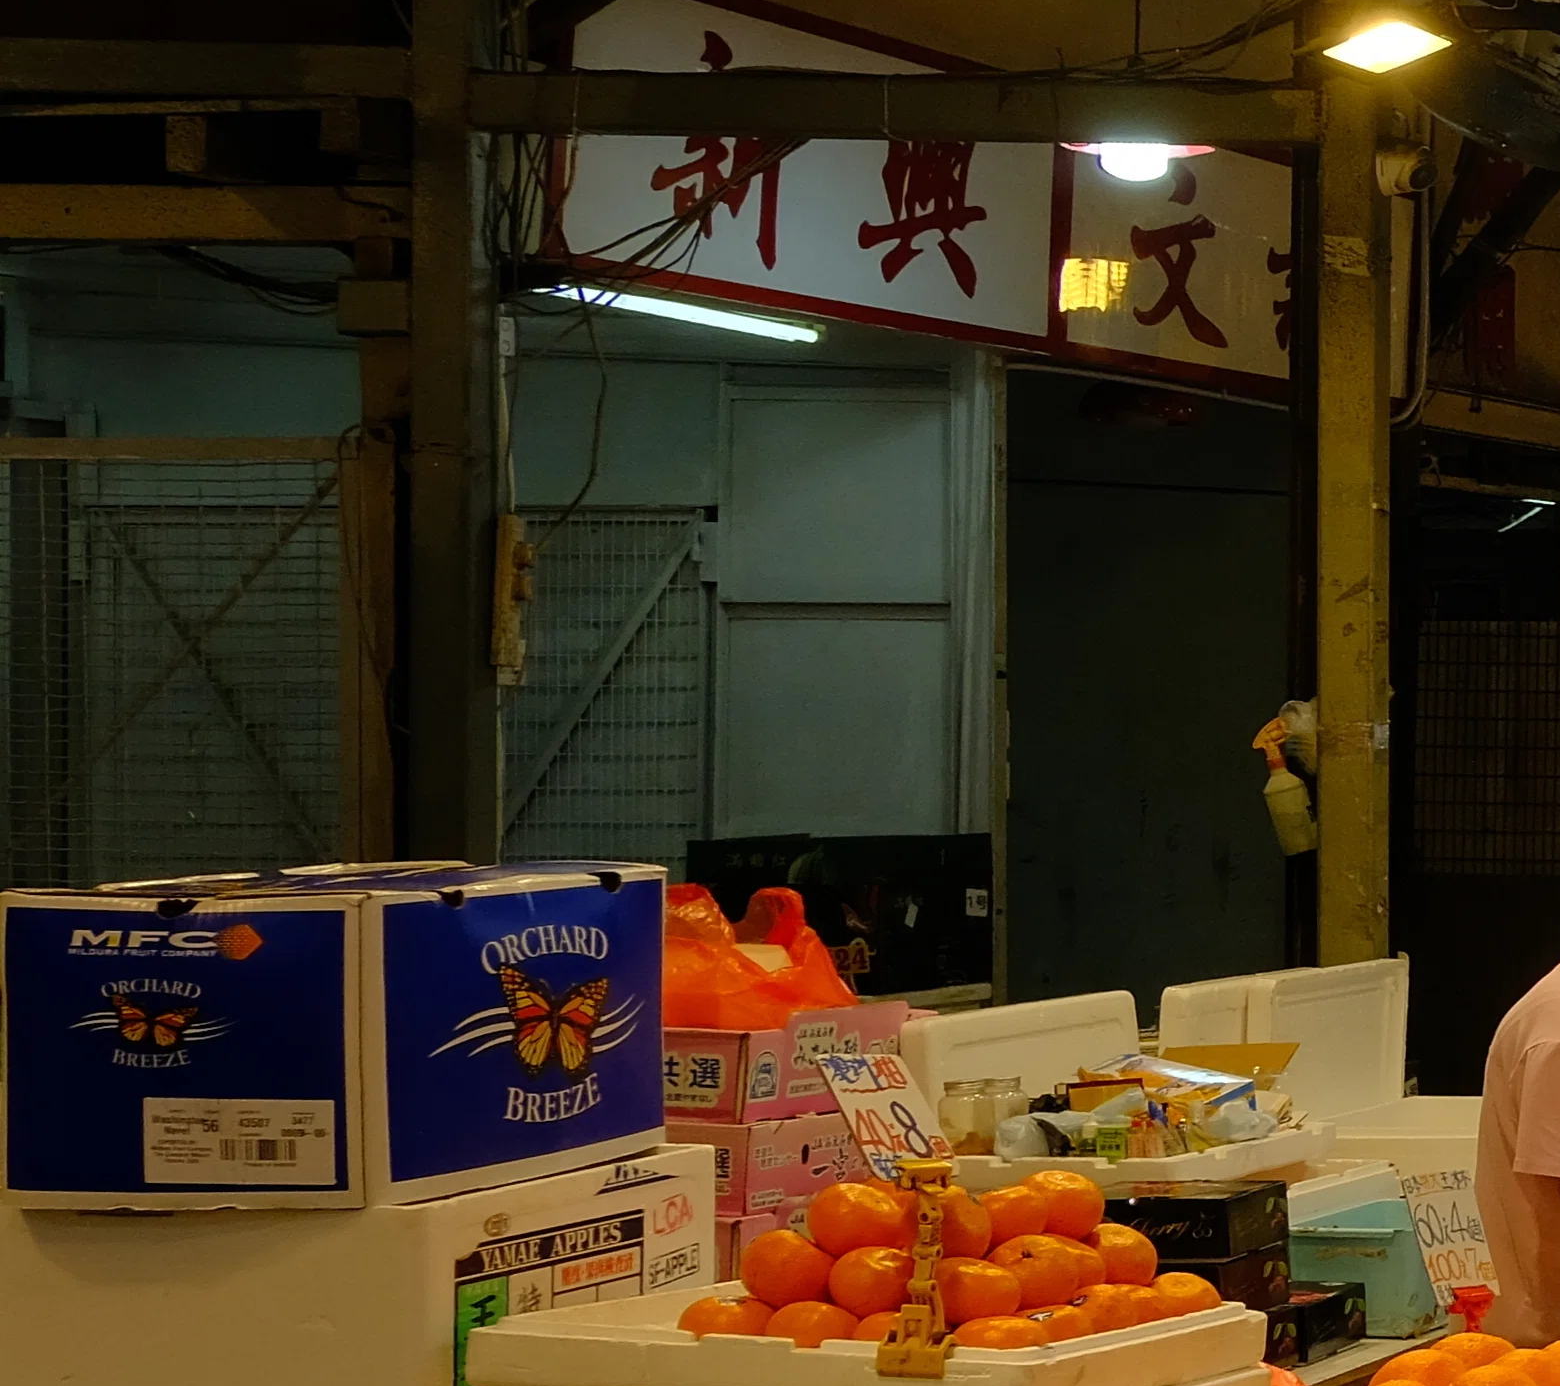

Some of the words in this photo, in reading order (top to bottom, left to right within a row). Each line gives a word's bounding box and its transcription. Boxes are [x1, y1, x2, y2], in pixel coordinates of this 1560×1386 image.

[70, 929, 218, 948] MFC
[481, 924, 608, 976] ORCHARD
[101, 977, 201, 999] ORCHARD
[112, 1049, 191, 1068] BREEZE
[503, 1072, 604, 1125] BREEZE
[480, 1239, 541, 1273] YAMAE
[551, 1222, 622, 1258] APPLES
